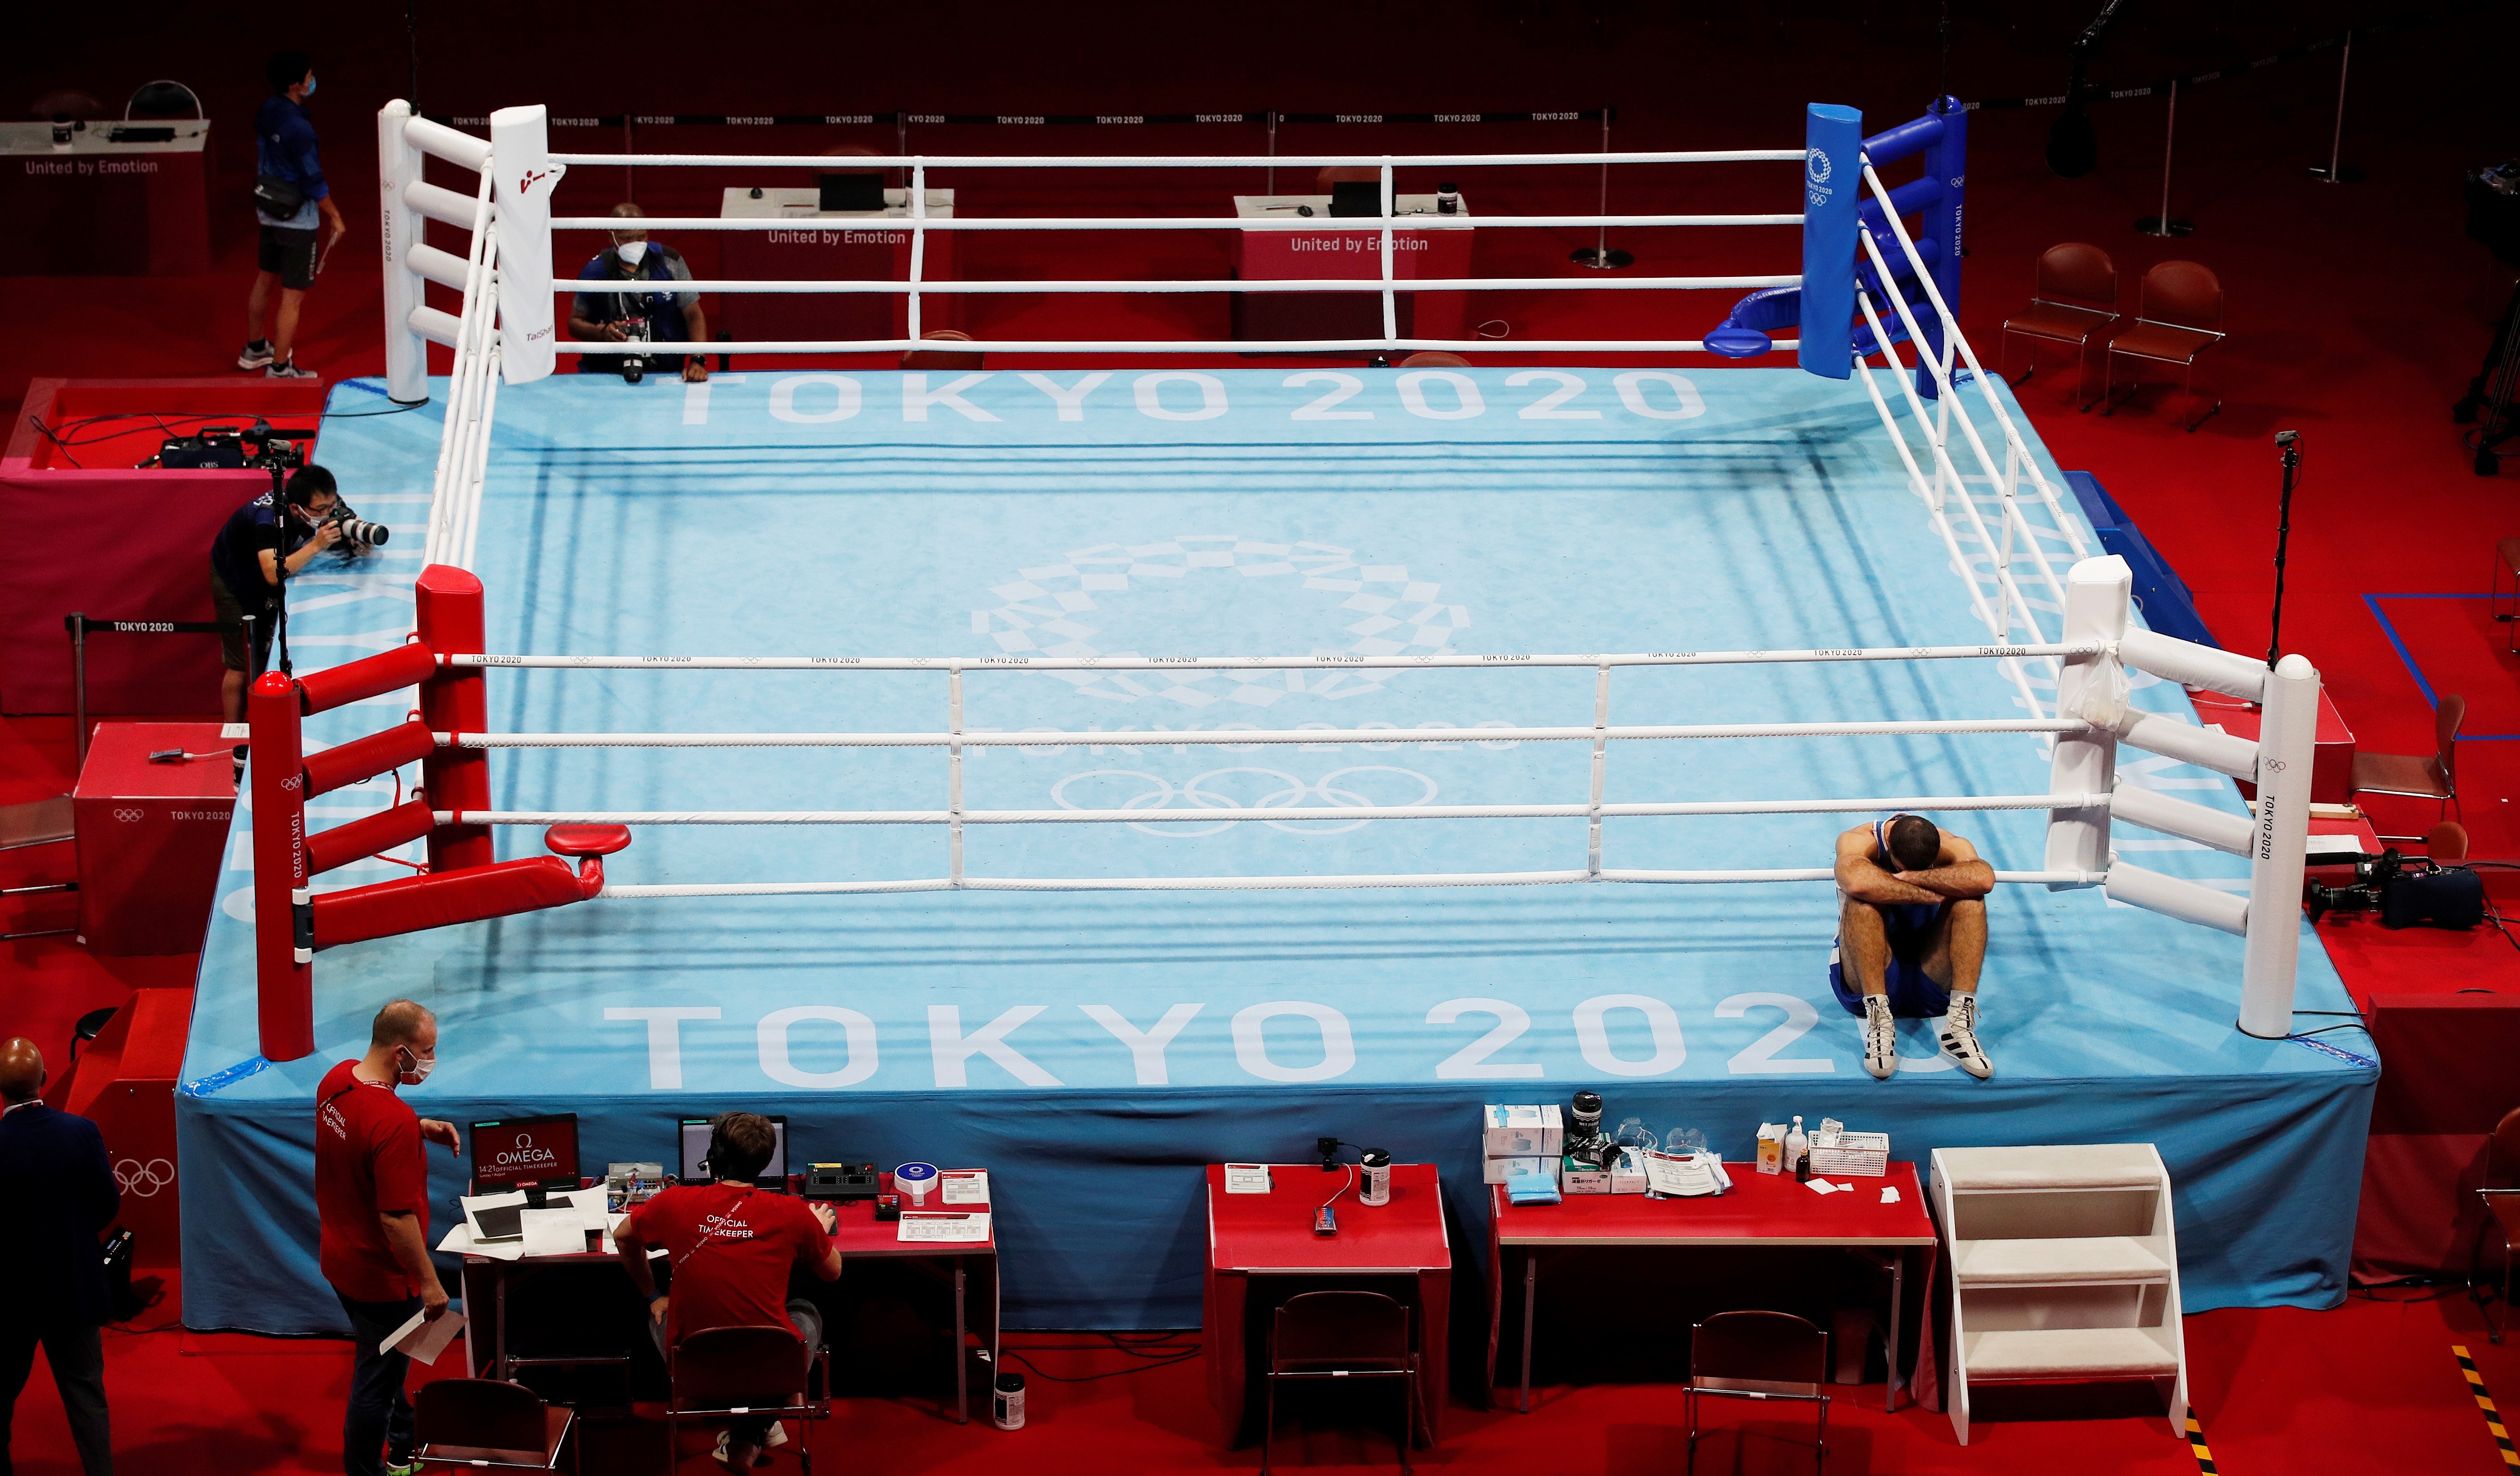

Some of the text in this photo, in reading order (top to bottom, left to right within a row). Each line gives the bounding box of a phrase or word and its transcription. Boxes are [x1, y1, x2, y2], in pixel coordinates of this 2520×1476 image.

[2024, 96, 2066, 106] TOKYO 2020
[2111, 88, 2151, 99] TOKYO 2020
[26, 159, 158, 176] United by Emotion
[1807, 180, 1832, 195] TOKYO 2020
[768, 230, 906, 246] United by Emotion
[1291, 237, 1340, 251] United
[1346, 237, 1362, 253] by
[655, 370, 1706, 425] TOKYO 2020
[114, 622, 174, 632] TOKYO 2020
[171, 811, 231, 820] TOKYO 2020
[2261, 795, 2275, 860] TOKYO 2020
[291, 811, 302, 878] TOKYO 2020
[604, 1001, 1356, 1089] TOKYO
[496, 1148, 555, 1165] OMEGA
[706, 1214, 748, 1228] OFCIAL
